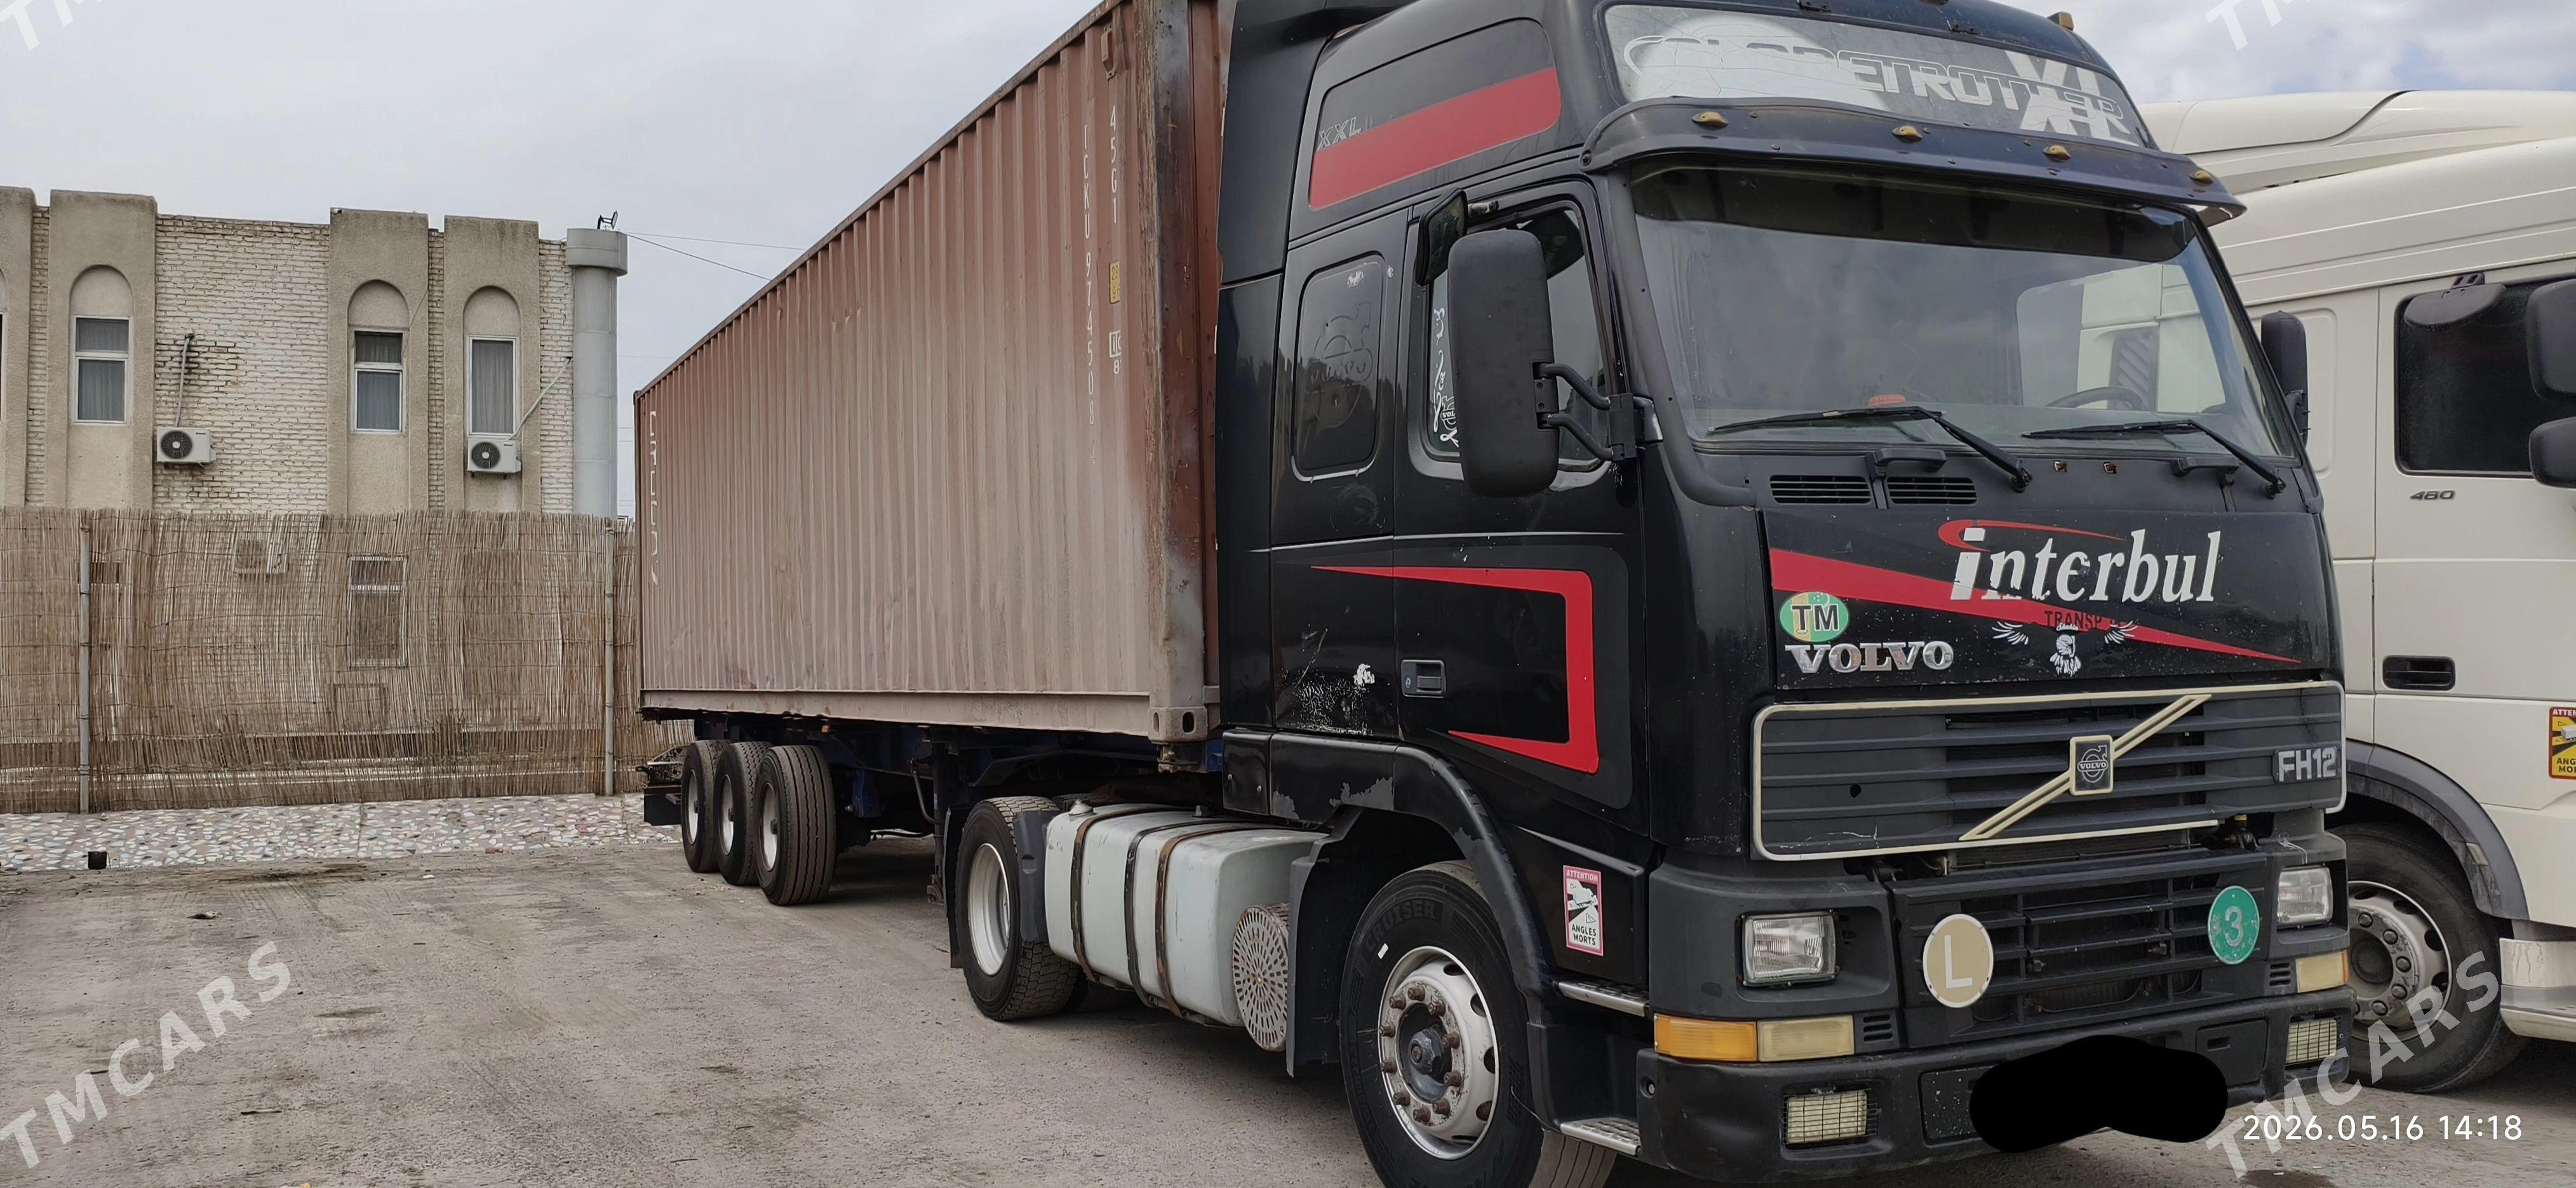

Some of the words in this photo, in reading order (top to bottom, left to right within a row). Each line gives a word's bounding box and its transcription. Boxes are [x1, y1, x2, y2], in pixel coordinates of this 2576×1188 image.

[2409, 490, 2456, 500] 480
[1790, 604, 1840, 632] TM
[1784, 641, 1954, 674] VOLVO
[2277, 746, 2337, 782] FH12
[1567, 870, 1598, 881] ATTENTION
[1572, 924, 1596, 936] ANGLES
[1574, 934, 1595, 945] MORTS
[2225, 907, 2245, 947] 3
[1944, 935, 1973, 989] L
